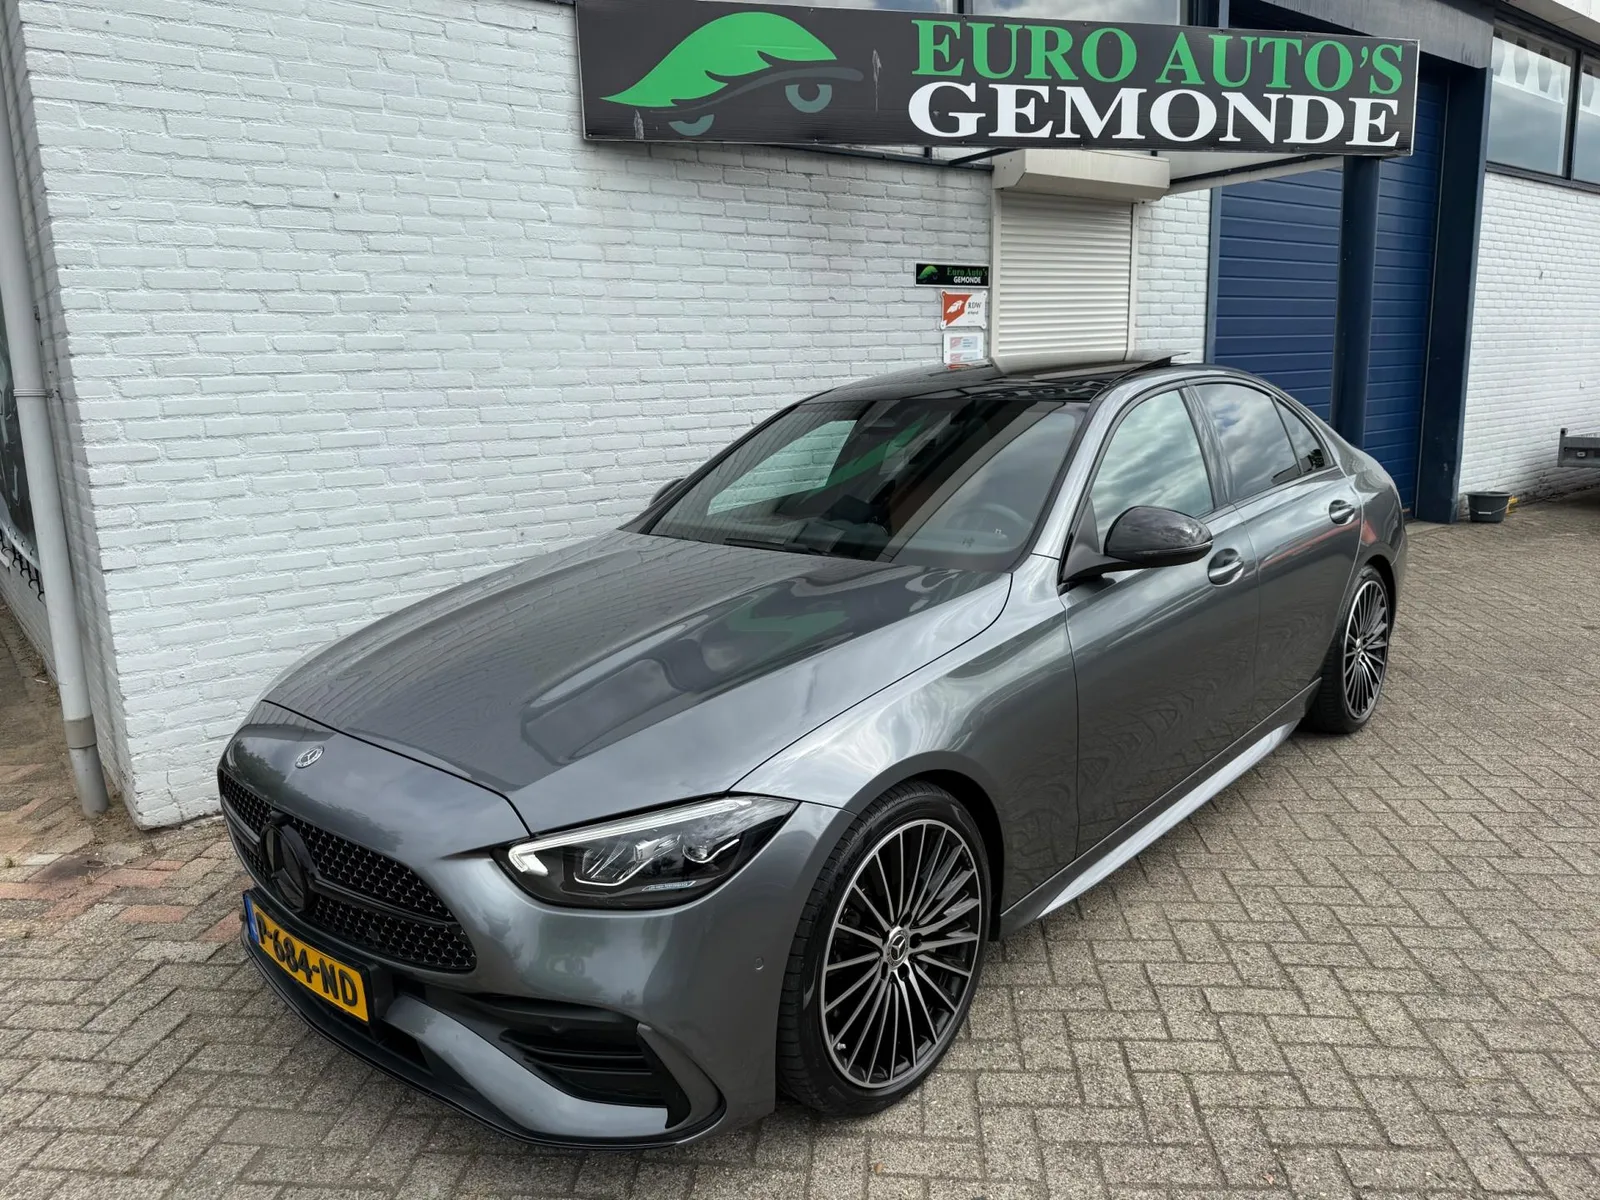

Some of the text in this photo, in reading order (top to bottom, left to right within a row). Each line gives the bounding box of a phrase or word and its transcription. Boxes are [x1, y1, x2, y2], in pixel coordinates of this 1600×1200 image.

[912, 19, 1403, 95] EURO AUTO'S
[908, 81, 1399, 147] GEMONDE
[946, 267, 965, 276] Euro
[953, 275, 981, 284] GEMONDE
[255, 911, 358, 1007] P-684-ND
